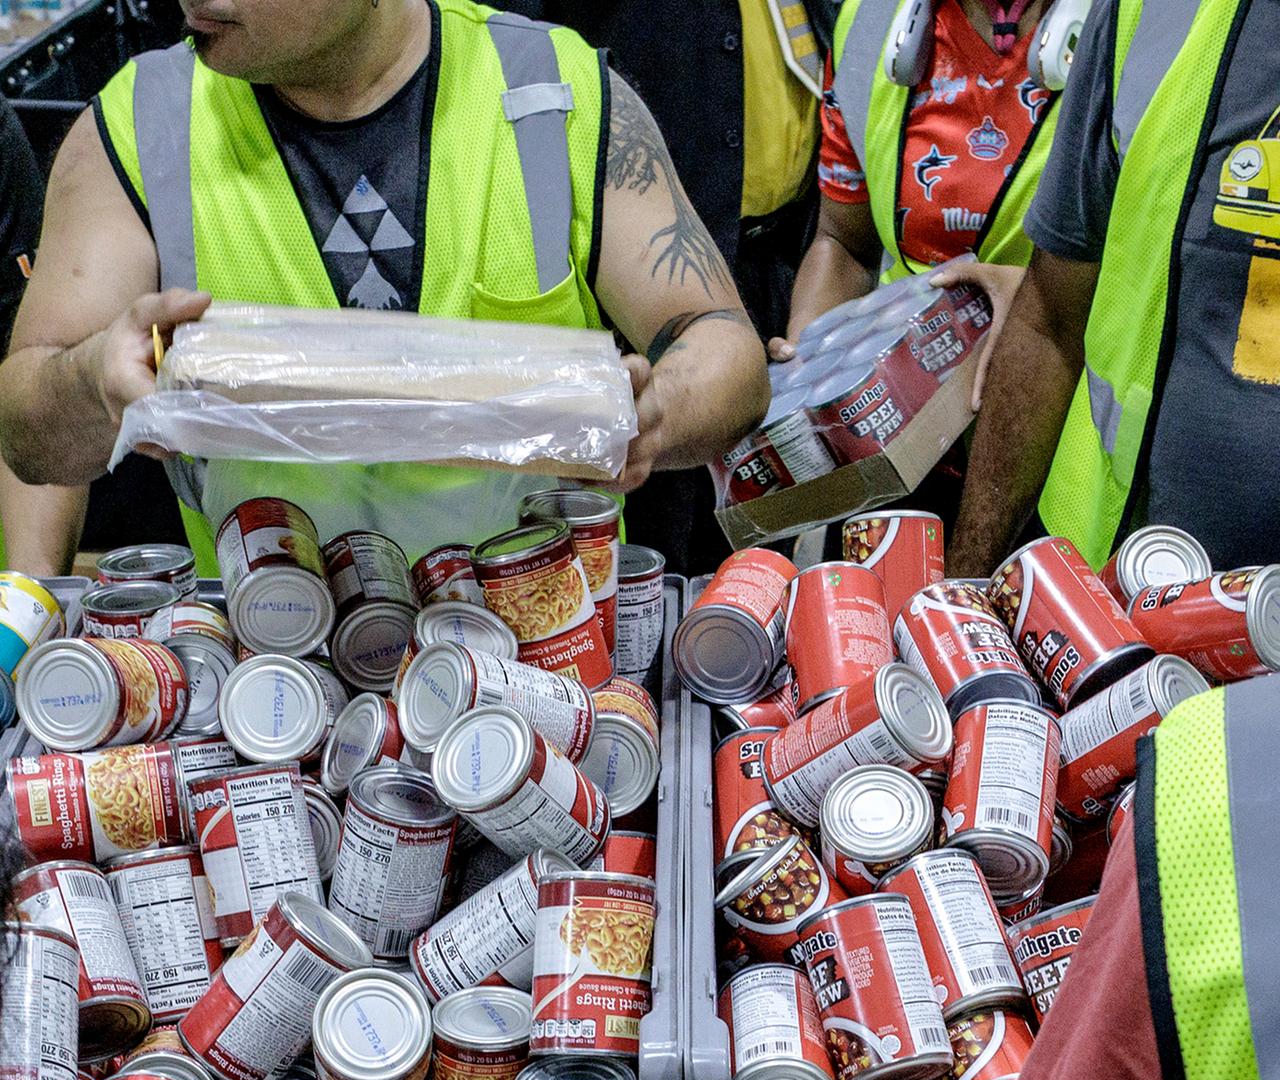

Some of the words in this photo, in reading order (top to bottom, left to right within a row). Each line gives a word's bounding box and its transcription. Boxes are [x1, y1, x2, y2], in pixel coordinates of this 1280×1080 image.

[942, 207, 986, 231] Mia
[840, 383, 887, 423] Southga
[618, 584, 646, 593] Nutrition
[543, 639, 594, 668] Spaghetti
[989, 708, 1019, 716] Nutrition
[181, 745, 216, 758] Nutrition
[53, 758, 66, 784] Rings
[230, 779, 268, 791] Nutrition
[270, 777, 289, 786] Facts
[34, 783, 49, 824] FINEST
[54, 785, 73, 849] Spaghetti
[236, 812, 261, 822] Calories
[265, 808, 280, 817] 150
[282, 804, 295, 813] 270
[373, 824, 395, 837] Facts
[400, 829, 435, 839] Spaghetti
[359, 846, 372, 857] 150
[375, 852, 391, 863] 270
[877, 906, 900, 914] Nutrition
[1016, 926, 1082, 962] uthgate
[420, 947, 431, 967] Facts
[447, 946, 457, 962] 150
[145, 972, 160, 982] 270
[163, 968, 178, 978] 150
[183, 964, 206, 972] Calories
[93, 983, 114, 991] Rings
[579, 983, 599, 991] Sauce
[600, 984, 623, 992] Cheese
[151, 1000, 173, 1009] Facts
[175, 996, 201, 1005] rition
[576, 995, 616, 1011] Rings
[619, 996, 650, 1015] ghetti
[41, 1044, 56, 1056] 270
